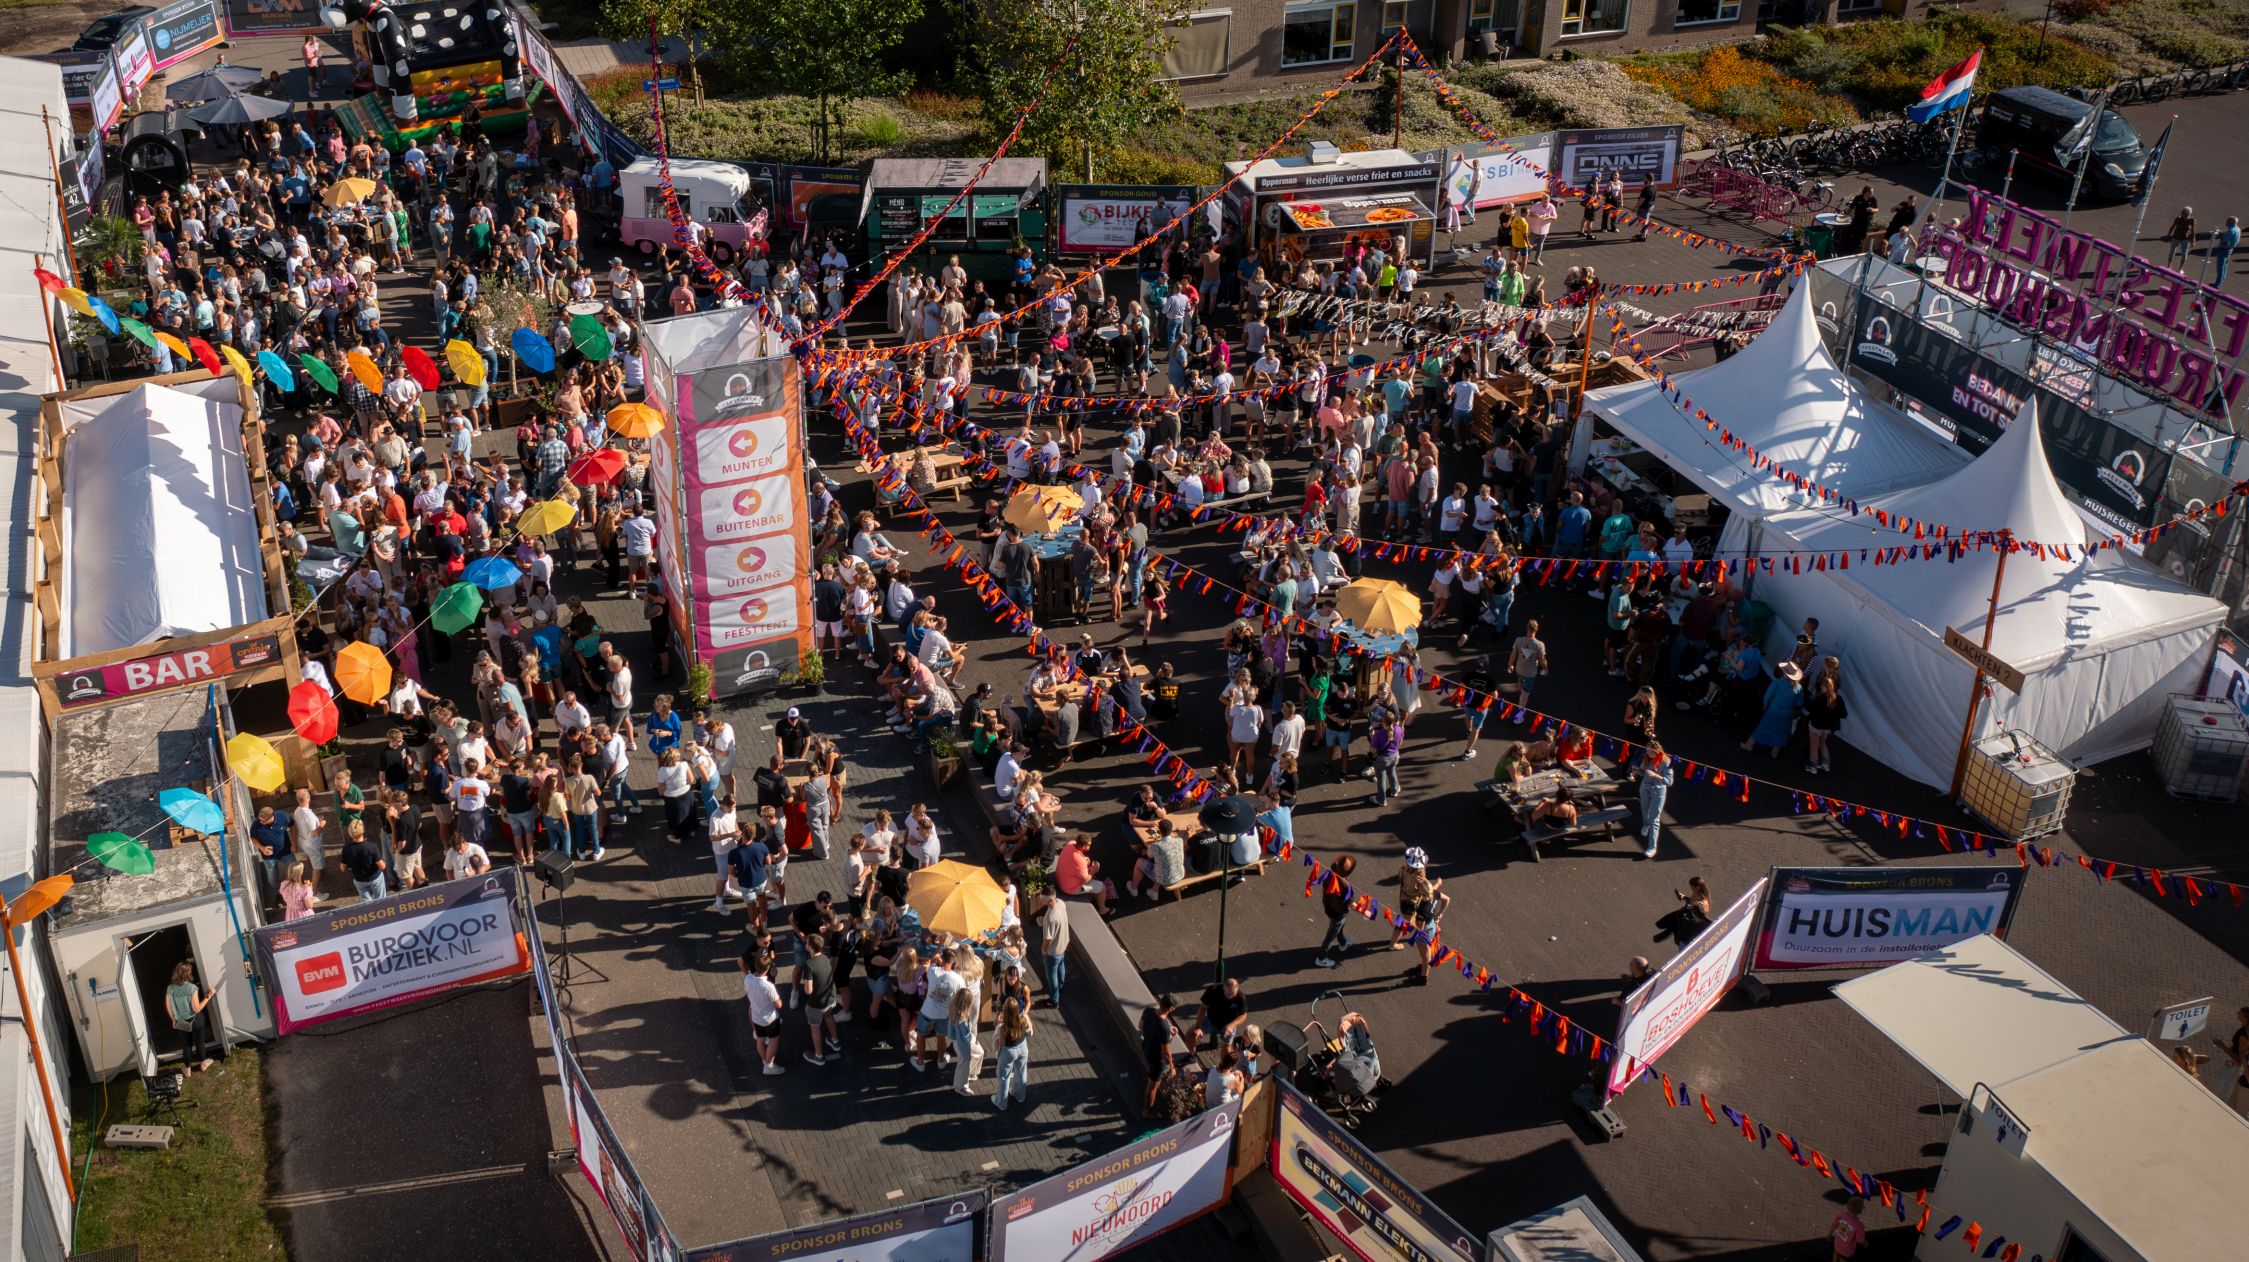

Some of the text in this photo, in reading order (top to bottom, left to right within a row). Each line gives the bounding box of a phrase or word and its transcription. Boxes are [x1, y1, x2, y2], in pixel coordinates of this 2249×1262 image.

[169, 13, 211, 38] NIJMEIJER
[1594, 132, 1650, 141] SPONSOR ZILVER
[1261, 167, 1433, 188] Opperman Heerlijke verse friet en snacks
[889, 199, 905, 207] MENU
[1100, 190, 1134, 198] SPONSOR
[1342, 197, 1413, 208] Opperman
[1104, 204, 1178, 219] BIJKEK
[1952, 386, 1969, 409] EN
[1972, 398, 2000, 423] TOT
[721, 456, 774, 475] MUNTEN
[716, 513, 785, 534] BUITENBAR
[727, 570, 782, 588] UITGANG
[724, 619, 789, 640] FEESTTENT
[124, 650, 214, 691] BAR
[1952, 635, 2011, 683] KLACHTEN ?
[1909, 877, 1953, 888] BRONS
[331, 894, 445, 932] SPONSOR BRONS
[1789, 905, 1994, 938] HUISMAN
[348, 913, 498, 965] BUROVOOR
[1666, 923, 1729, 983] SPONSOR BRONS
[1784, 941, 1843, 953] Duurzaam
[1846, 945, 1857, 954] in
[1863, 944, 1876, 953] de
[303, 938, 482, 984] BVM MUZIEK.NL
[1686, 967, 1700, 995] B
[1648, 963, 1725, 1041] BOSHOEVE
[2168, 1005, 2208, 1022] TOILET
[1989, 1101, 2026, 1140] TOILET
[1066, 1138, 1179, 1193] SPONSOR BRONS
[1327, 1130, 1423, 1216] SPONSOR BRONS
[1304, 1156, 1372, 1220] BEKMANN
[1071, 1190, 1173, 1247] NIEUWOORD
[771, 1218, 904, 1257] SPONSOR BRONS
